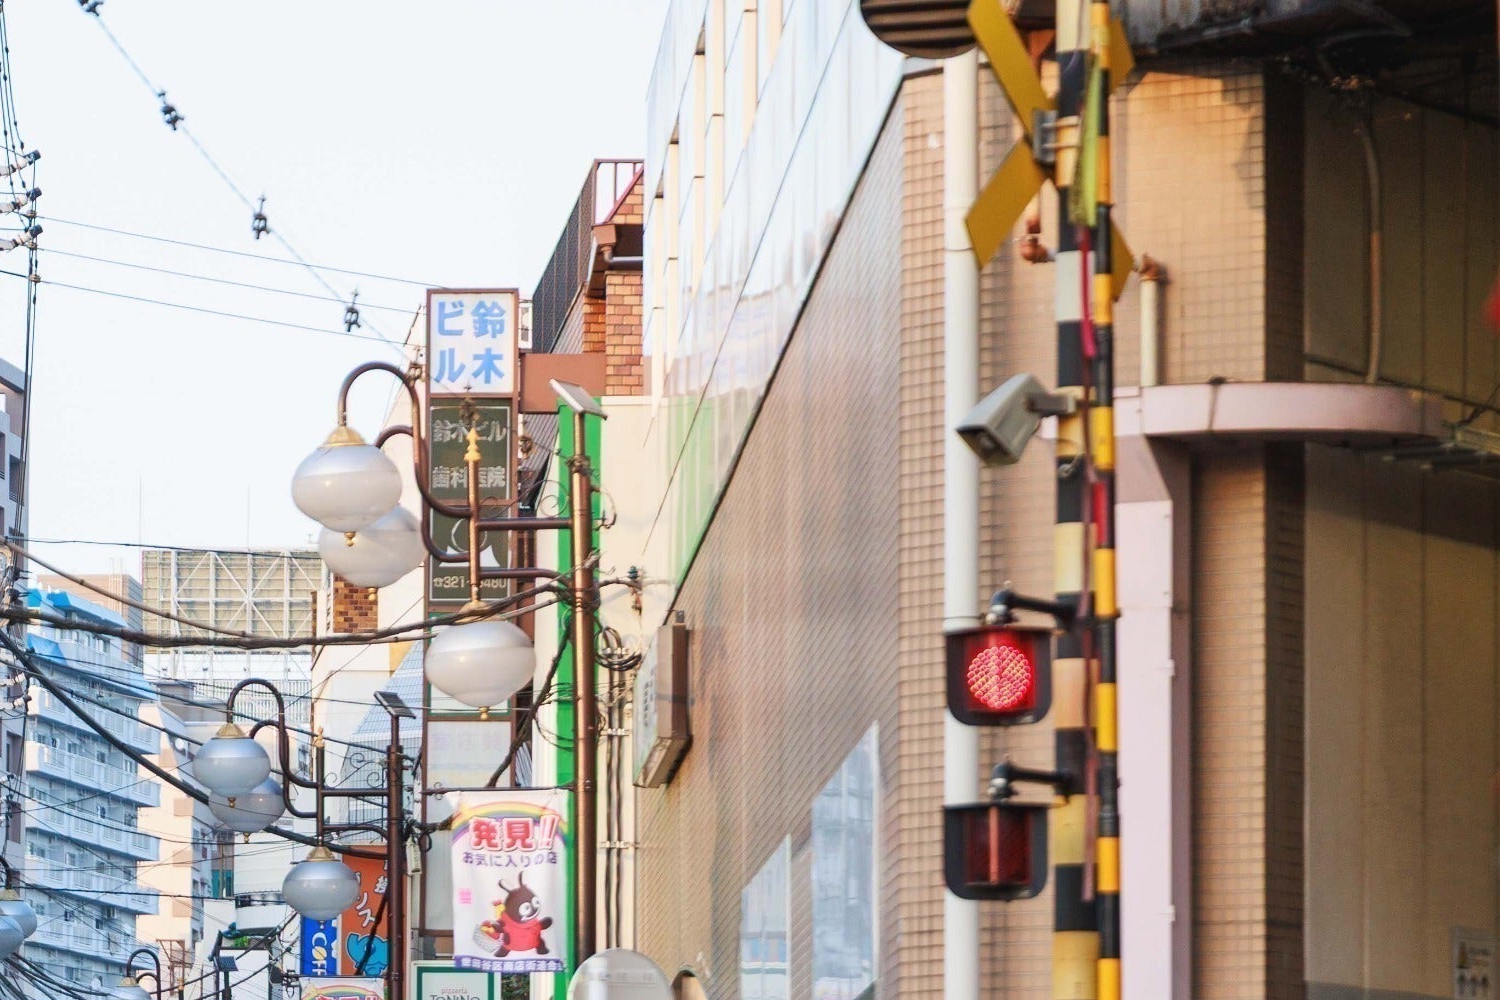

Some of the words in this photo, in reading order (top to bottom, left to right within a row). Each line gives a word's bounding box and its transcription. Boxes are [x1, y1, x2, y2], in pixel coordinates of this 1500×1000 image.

[435, 301, 465, 384] ビル
[471, 301, 506, 384] 鈴木
[433, 420, 507, 443] 鈴木ビル
[432, 465, 507, 488] 歯科医院
[463, 851, 558, 868] お気に入りの店
